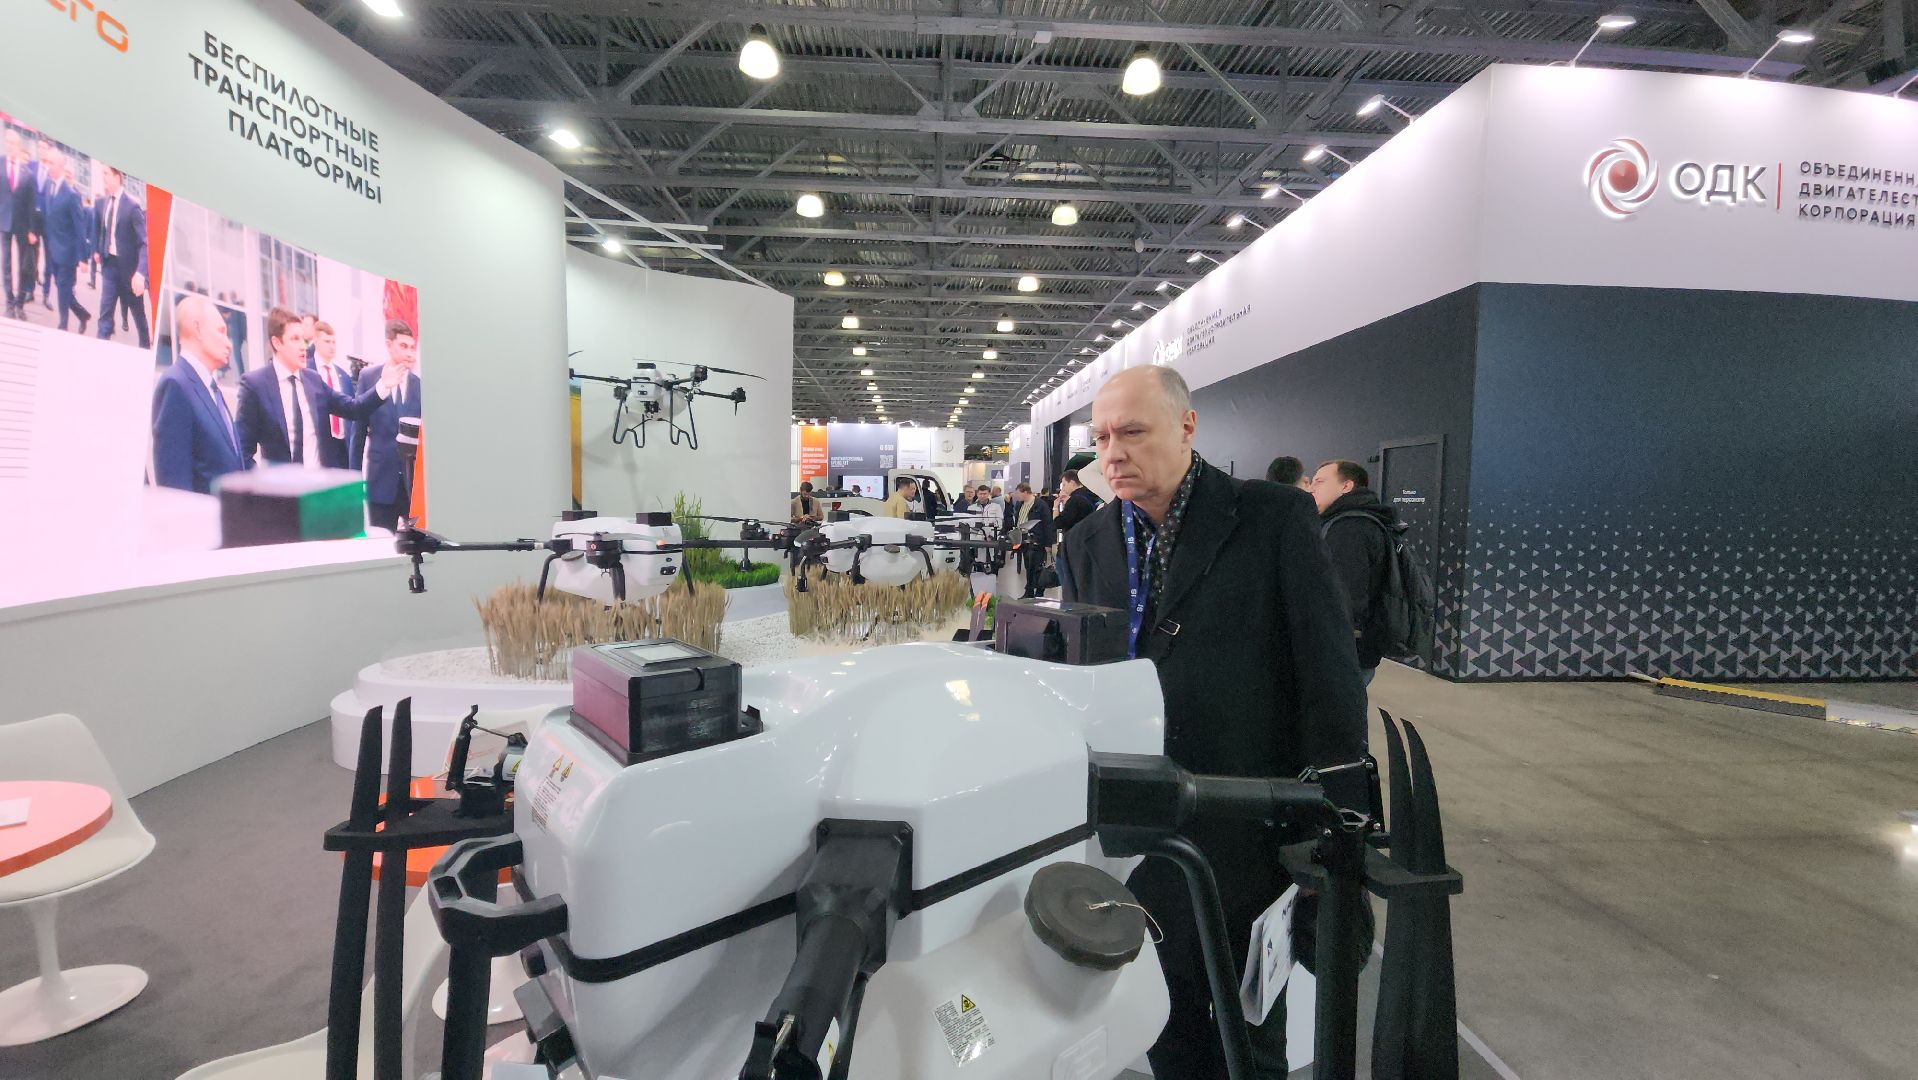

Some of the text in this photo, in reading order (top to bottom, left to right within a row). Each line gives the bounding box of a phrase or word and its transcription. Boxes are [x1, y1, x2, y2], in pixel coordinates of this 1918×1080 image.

[188, 52, 381, 178] ТРАНСПОРТНЫЕ
[204, 30, 379, 153] БЕСПИЛОТНЫЕ
[228, 108, 382, 204] ПЛАТФОРМЫ
[1673, 161, 1767, 204] ОДК
[1800, 161, 1918, 187] ОБЪЕДИНЕНН
[1799, 203, 1915, 227] КОРПОРАЦИЯ
